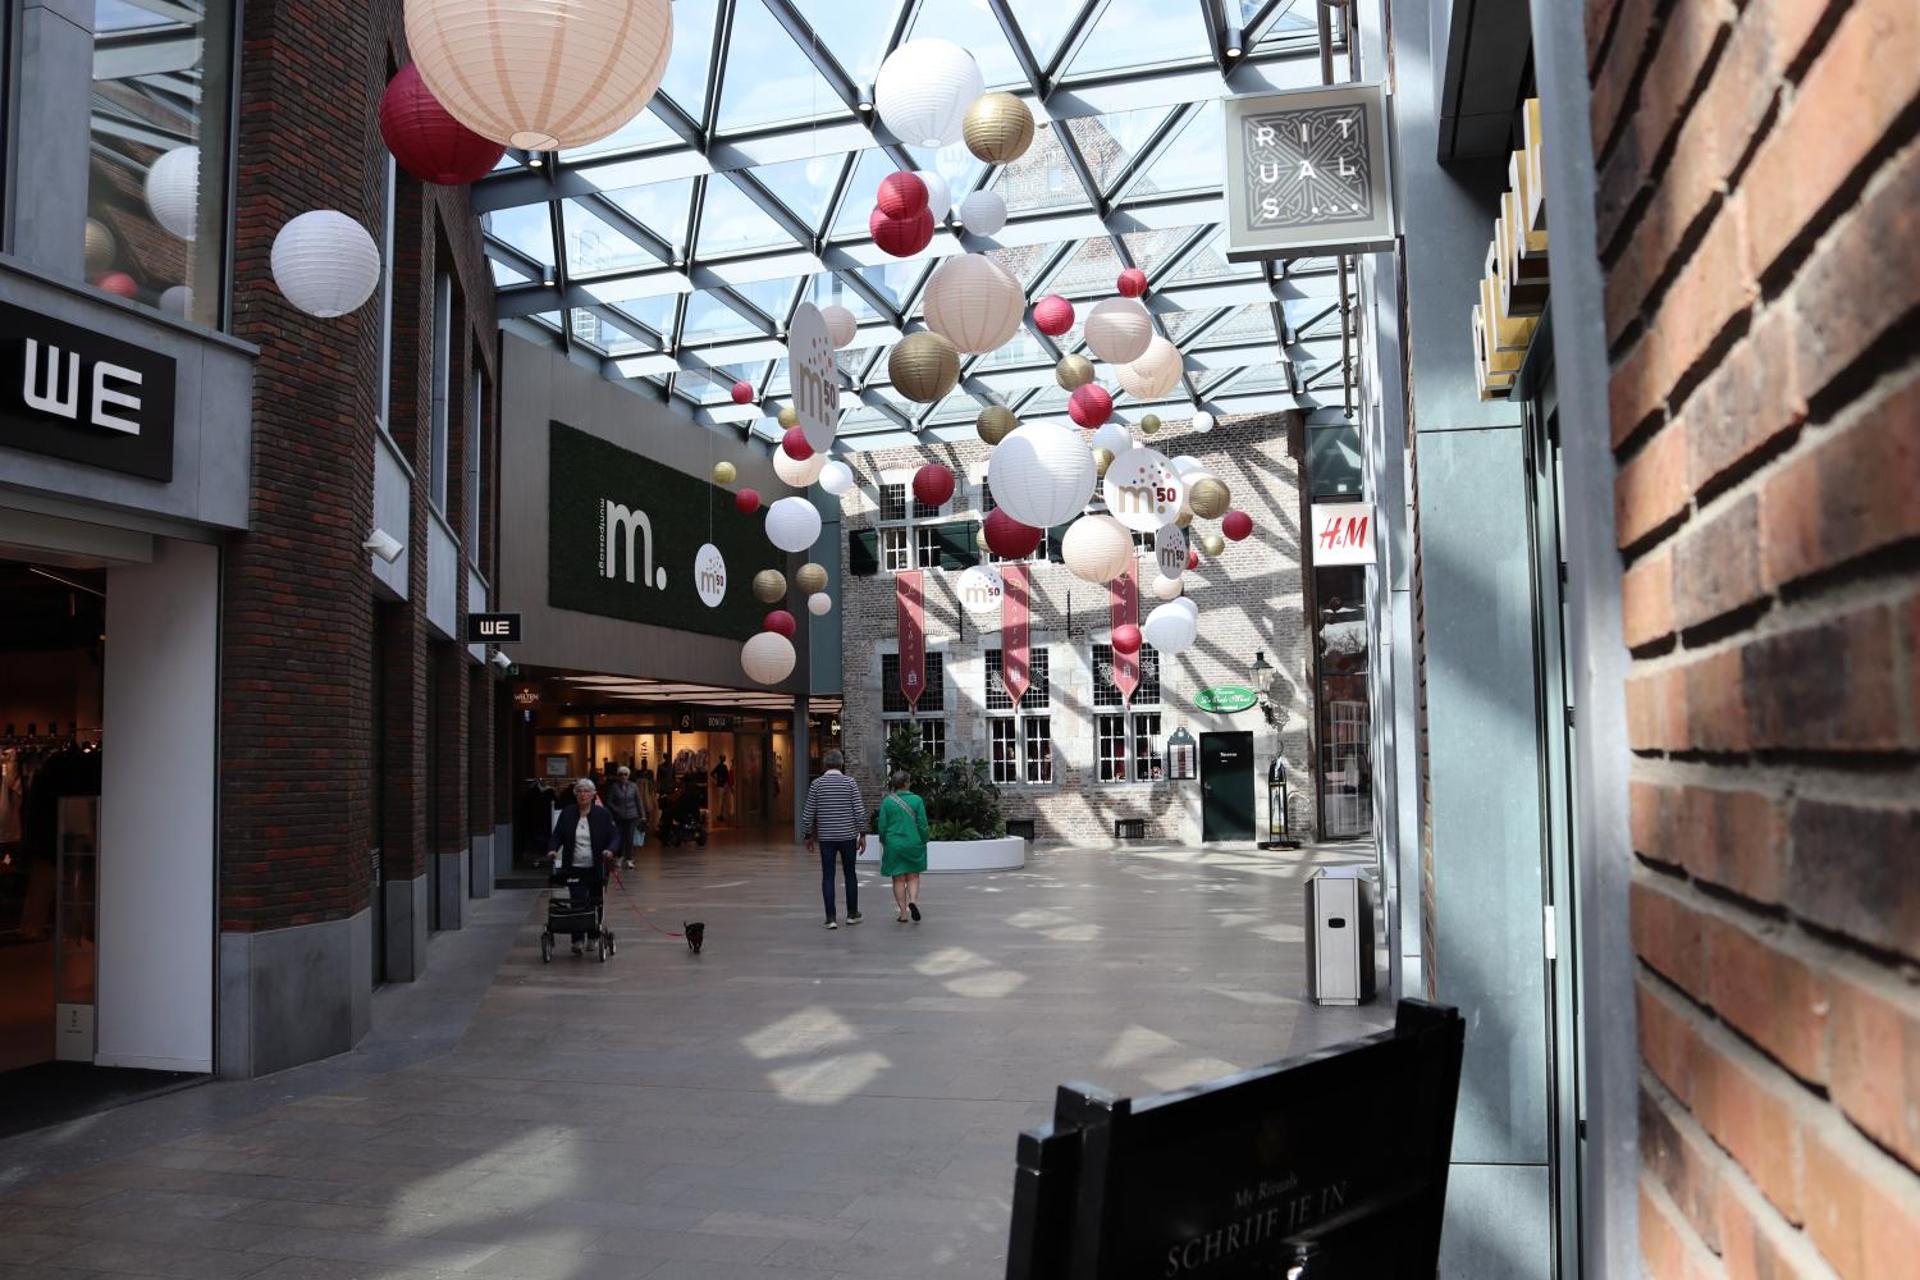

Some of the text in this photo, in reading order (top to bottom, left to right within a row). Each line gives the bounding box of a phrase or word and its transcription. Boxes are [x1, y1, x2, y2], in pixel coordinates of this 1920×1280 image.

[24, 337, 143, 436] WE
[1319, 516, 1368, 550] H&M
[480, 621, 510, 635] WE
[1322, 1179, 1347, 1215] IN
